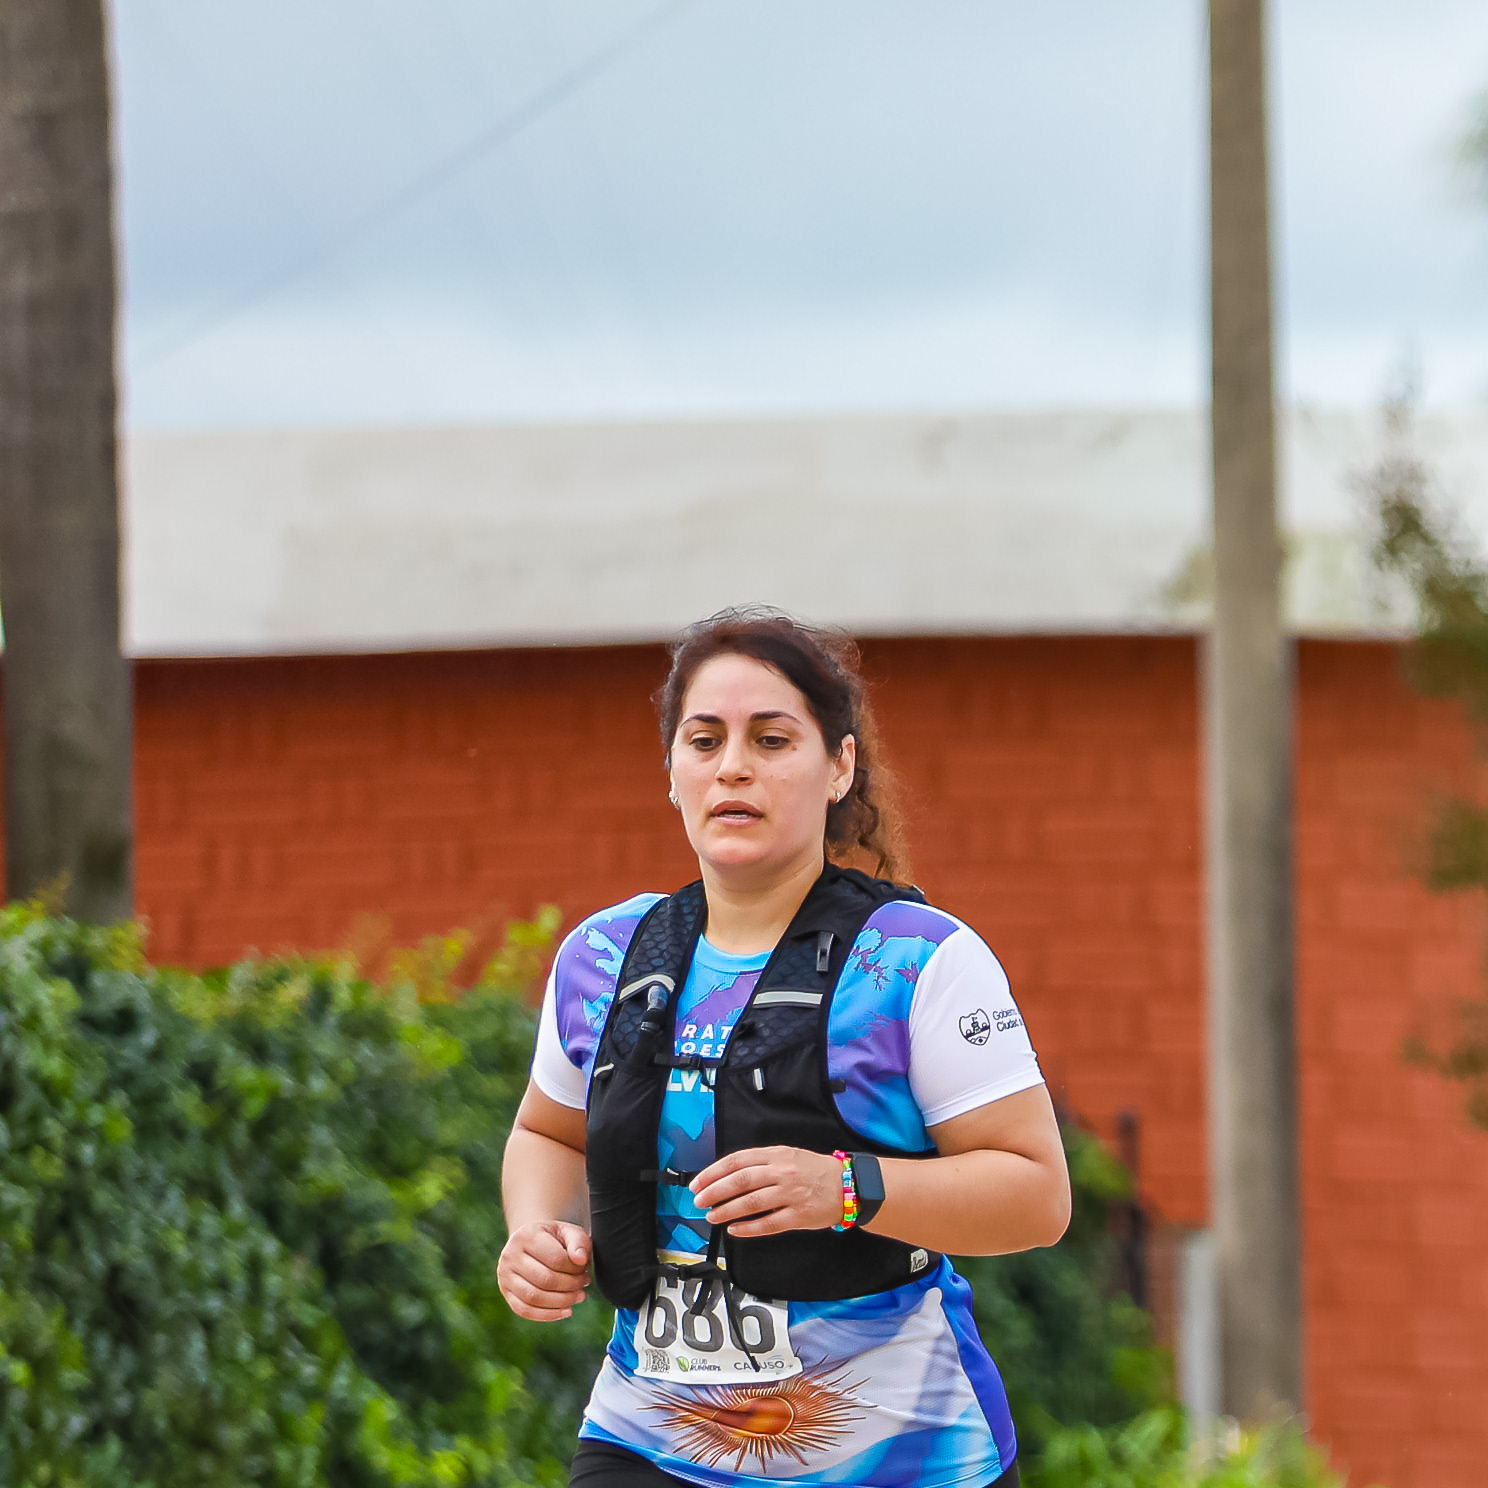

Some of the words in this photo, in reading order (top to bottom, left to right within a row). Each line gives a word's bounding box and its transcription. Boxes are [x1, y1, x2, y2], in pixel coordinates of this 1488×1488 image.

[674, 1041, 726, 1057] OES
[645, 1278, 776, 1354] 686
[734, 1360, 785, 1370] CAUSO
